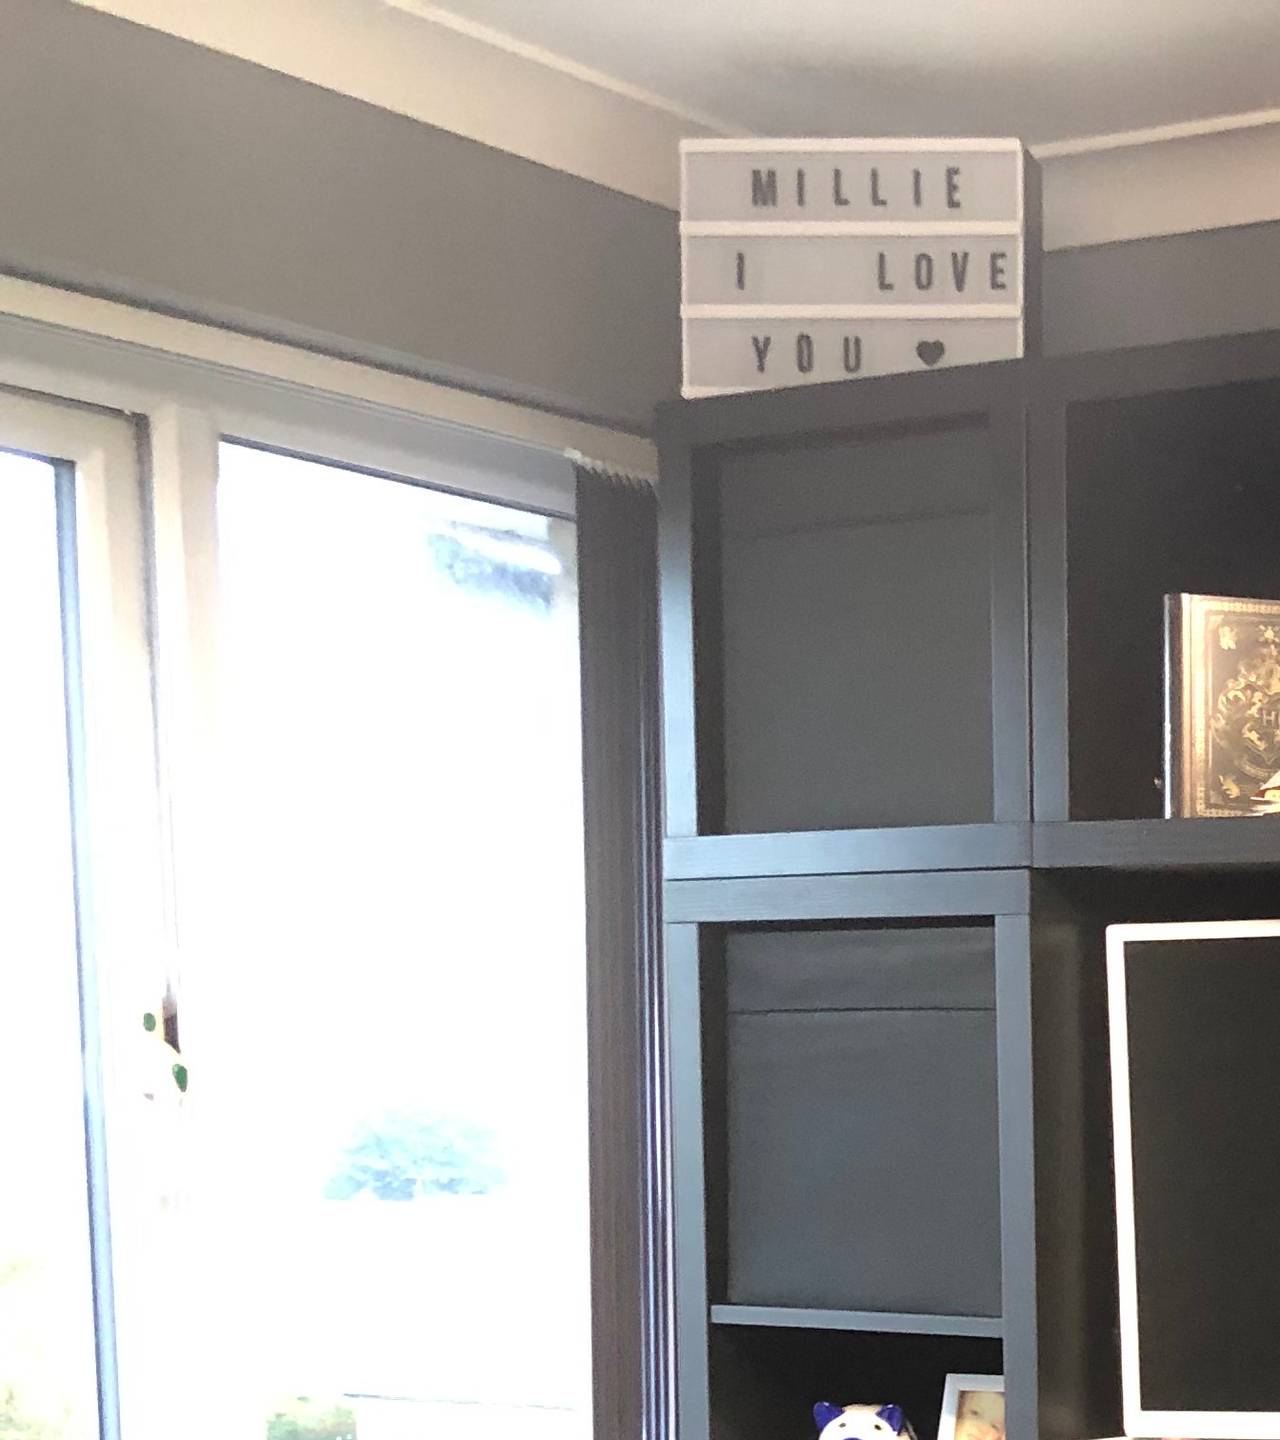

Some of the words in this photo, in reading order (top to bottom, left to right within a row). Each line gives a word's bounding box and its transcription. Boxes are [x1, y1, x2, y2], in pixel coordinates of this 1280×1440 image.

[752, 166, 961, 208] MILLIE
[736, 252, 745, 290] I
[878, 252, 1007, 292] LOVE
[752, 333, 862, 373] YOU
